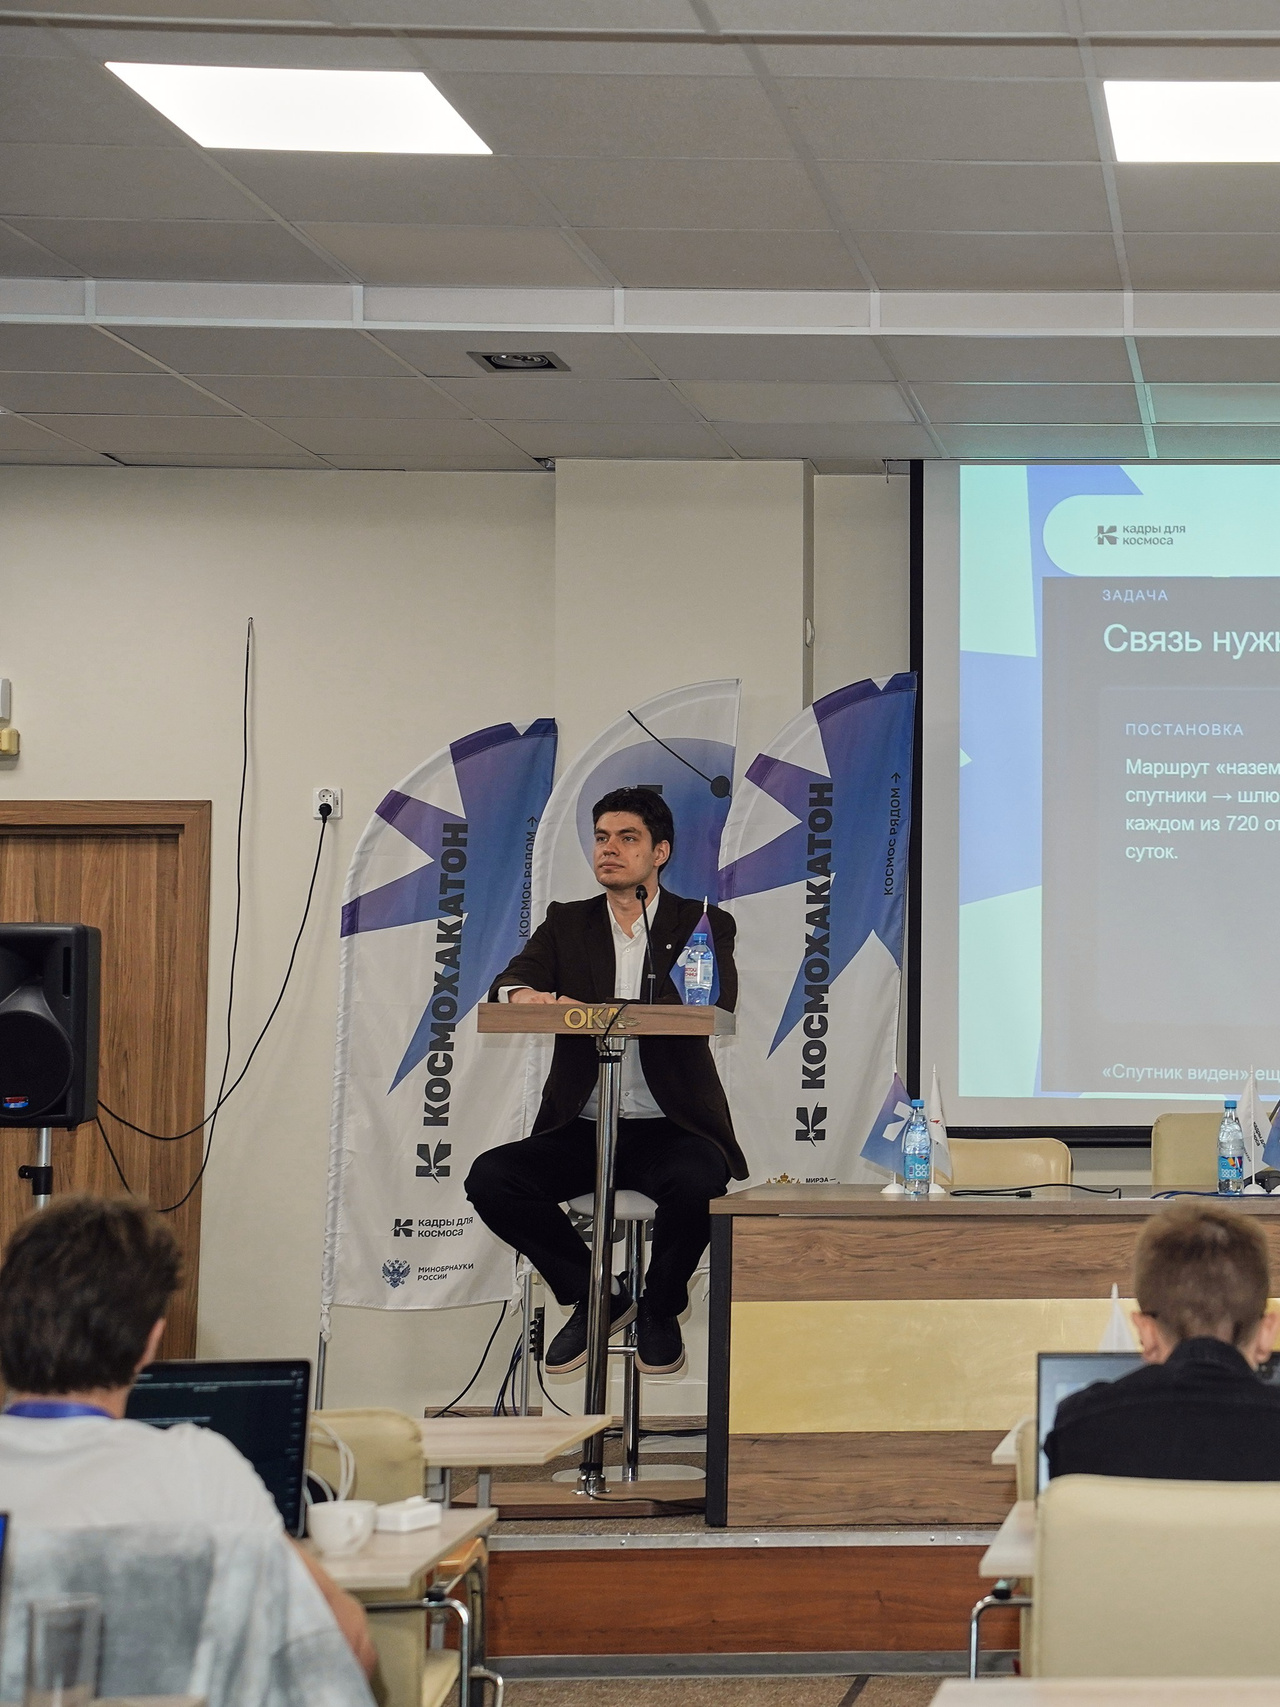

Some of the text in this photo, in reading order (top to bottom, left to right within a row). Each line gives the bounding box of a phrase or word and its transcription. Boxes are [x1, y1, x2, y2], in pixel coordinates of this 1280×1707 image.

[1122, 525, 1186, 537] кадры для
[1122, 535, 1174, 546] космоса
[1102, 589, 1169, 604] ЗАДАЧА
[1103, 623, 1203, 653] Связь
[1125, 723, 1244, 737] ПОСТАНОВКА
[1125, 758, 1211, 779] Маршрут
[1125, 790, 1207, 807] спутники
[1125, 818, 1195, 834] каждом
[1200, 818, 1221, 832] из
[1225, 815, 1259, 832] 720
[884, 787, 902, 896] КОСМОС РЯДОМ
[1125, 846, 1179, 863] суток.
[518, 831, 536, 938] КОСМОС РЯДОМ
[801, 781, 834, 1090] КОСМОХАКАТОН
[423, 821, 469, 1127] КОСМОХАКАТОН
[1102, 1063, 1183, 1083] «Спутник
[805, 1176, 829, 1184] МИРЭА
[418, 1216, 474, 1229] кадры для
[417, 1228, 464, 1238] космоса
[418, 1262, 474, 1273] МИНОБРНАУКИ
[417, 1273, 448, 1281] РОССИИ
